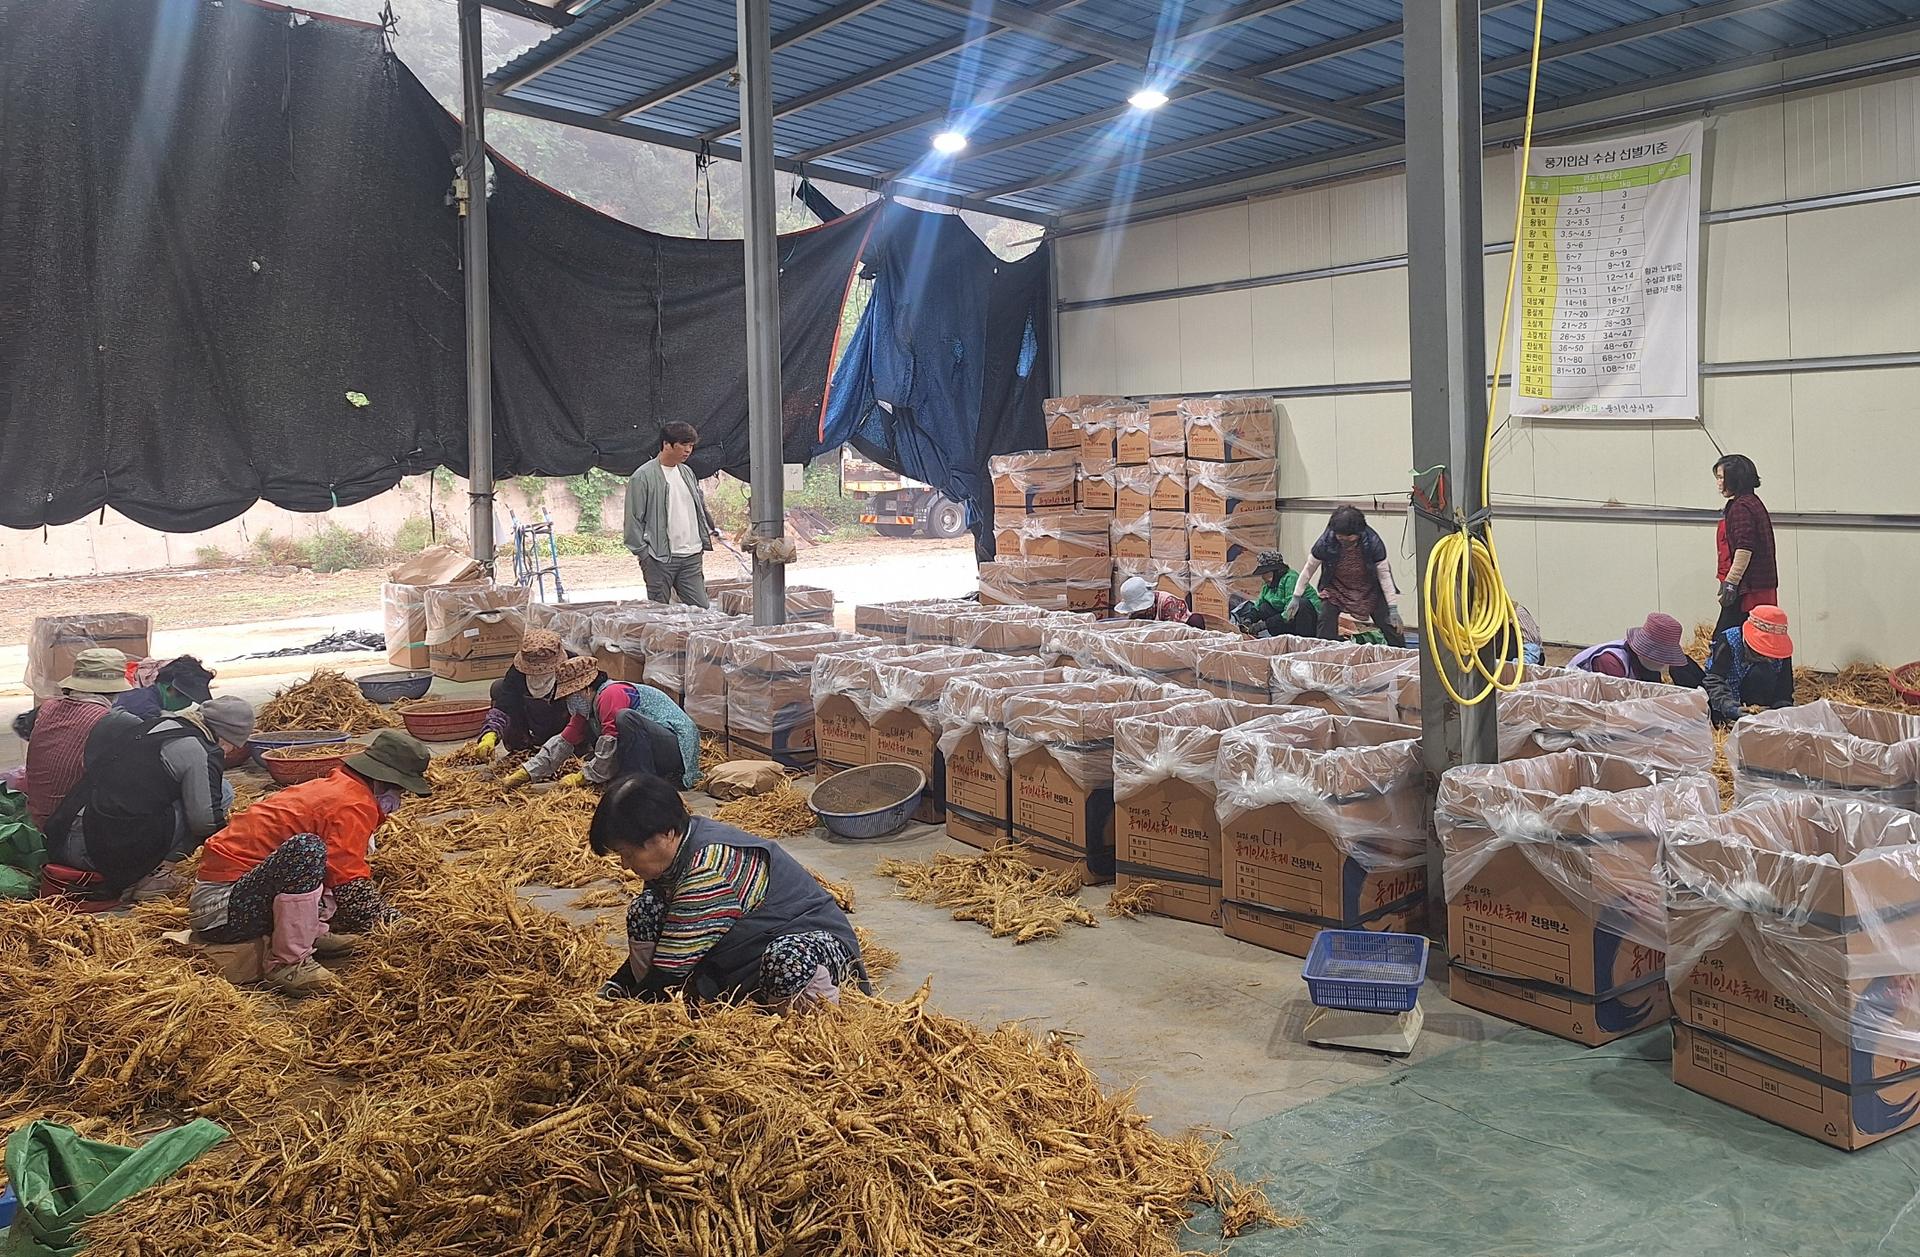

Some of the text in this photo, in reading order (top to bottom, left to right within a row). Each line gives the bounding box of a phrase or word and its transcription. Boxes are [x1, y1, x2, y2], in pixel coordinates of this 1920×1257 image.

[1544, 141, 1668, 169] 풍기인삼 수삼 선별기준
[1566, 241, 1583, 249] 5~6
[1610, 249, 1628, 257] 8~9
[1608, 260, 1631, 269] 9~12
[1606, 272, 1633, 281] 12~14
[1603, 330, 1632, 339] 34~47
[1603, 341, 1634, 350] 48~67
[1602, 352, 1637, 361] 68~107
[1291, 856, 1323, 872] 전용박스
[1531, 915, 1570, 935] 전용박스
[1554, 973, 1564, 984] kg
